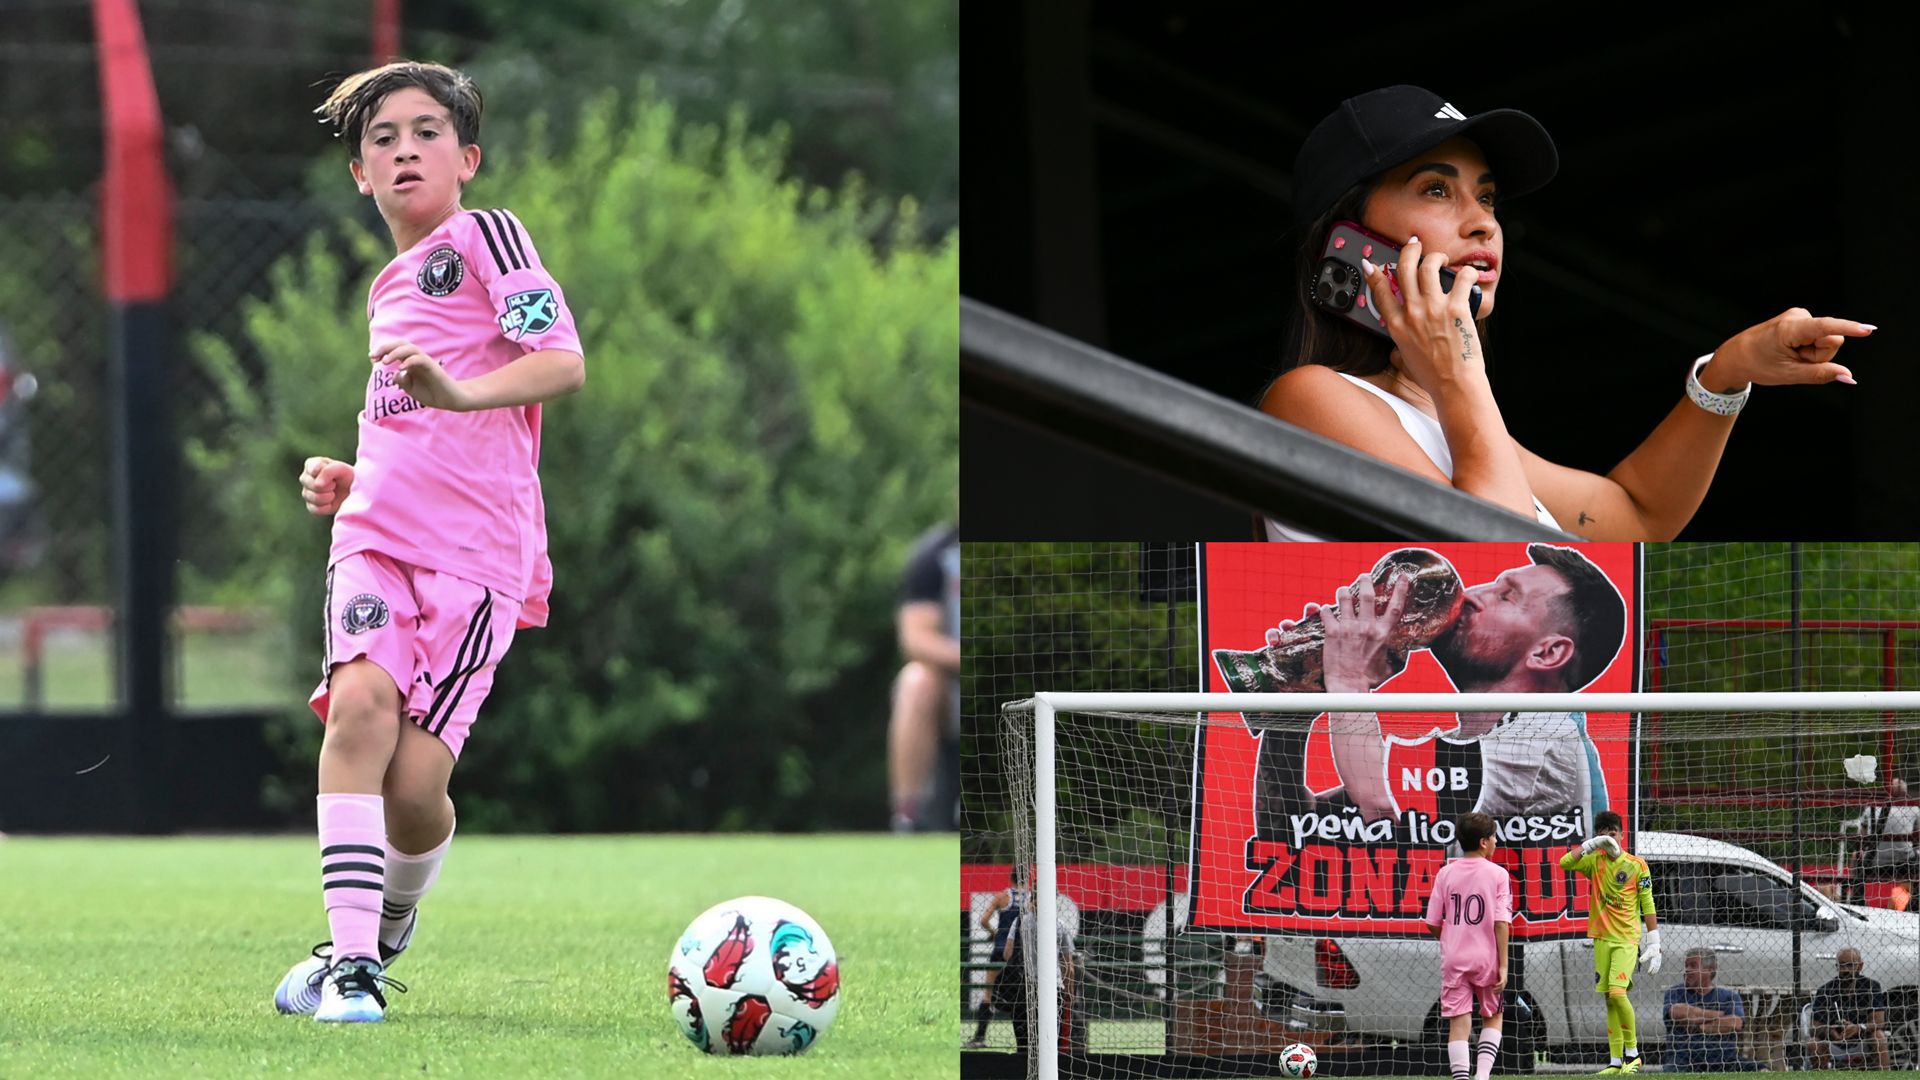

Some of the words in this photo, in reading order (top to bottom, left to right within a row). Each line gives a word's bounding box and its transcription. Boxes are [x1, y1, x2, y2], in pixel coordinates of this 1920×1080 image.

[500, 296, 557, 336] NEXT
[510, 294, 531, 307] MLS
[1460, 327, 1474, 361] Thiago
[1402, 766, 1470, 792] NOB
[1290, 806, 1393, 849] peña
[1249, 841, 1446, 914] ZONA
[1450, 893, 1486, 926] 10
